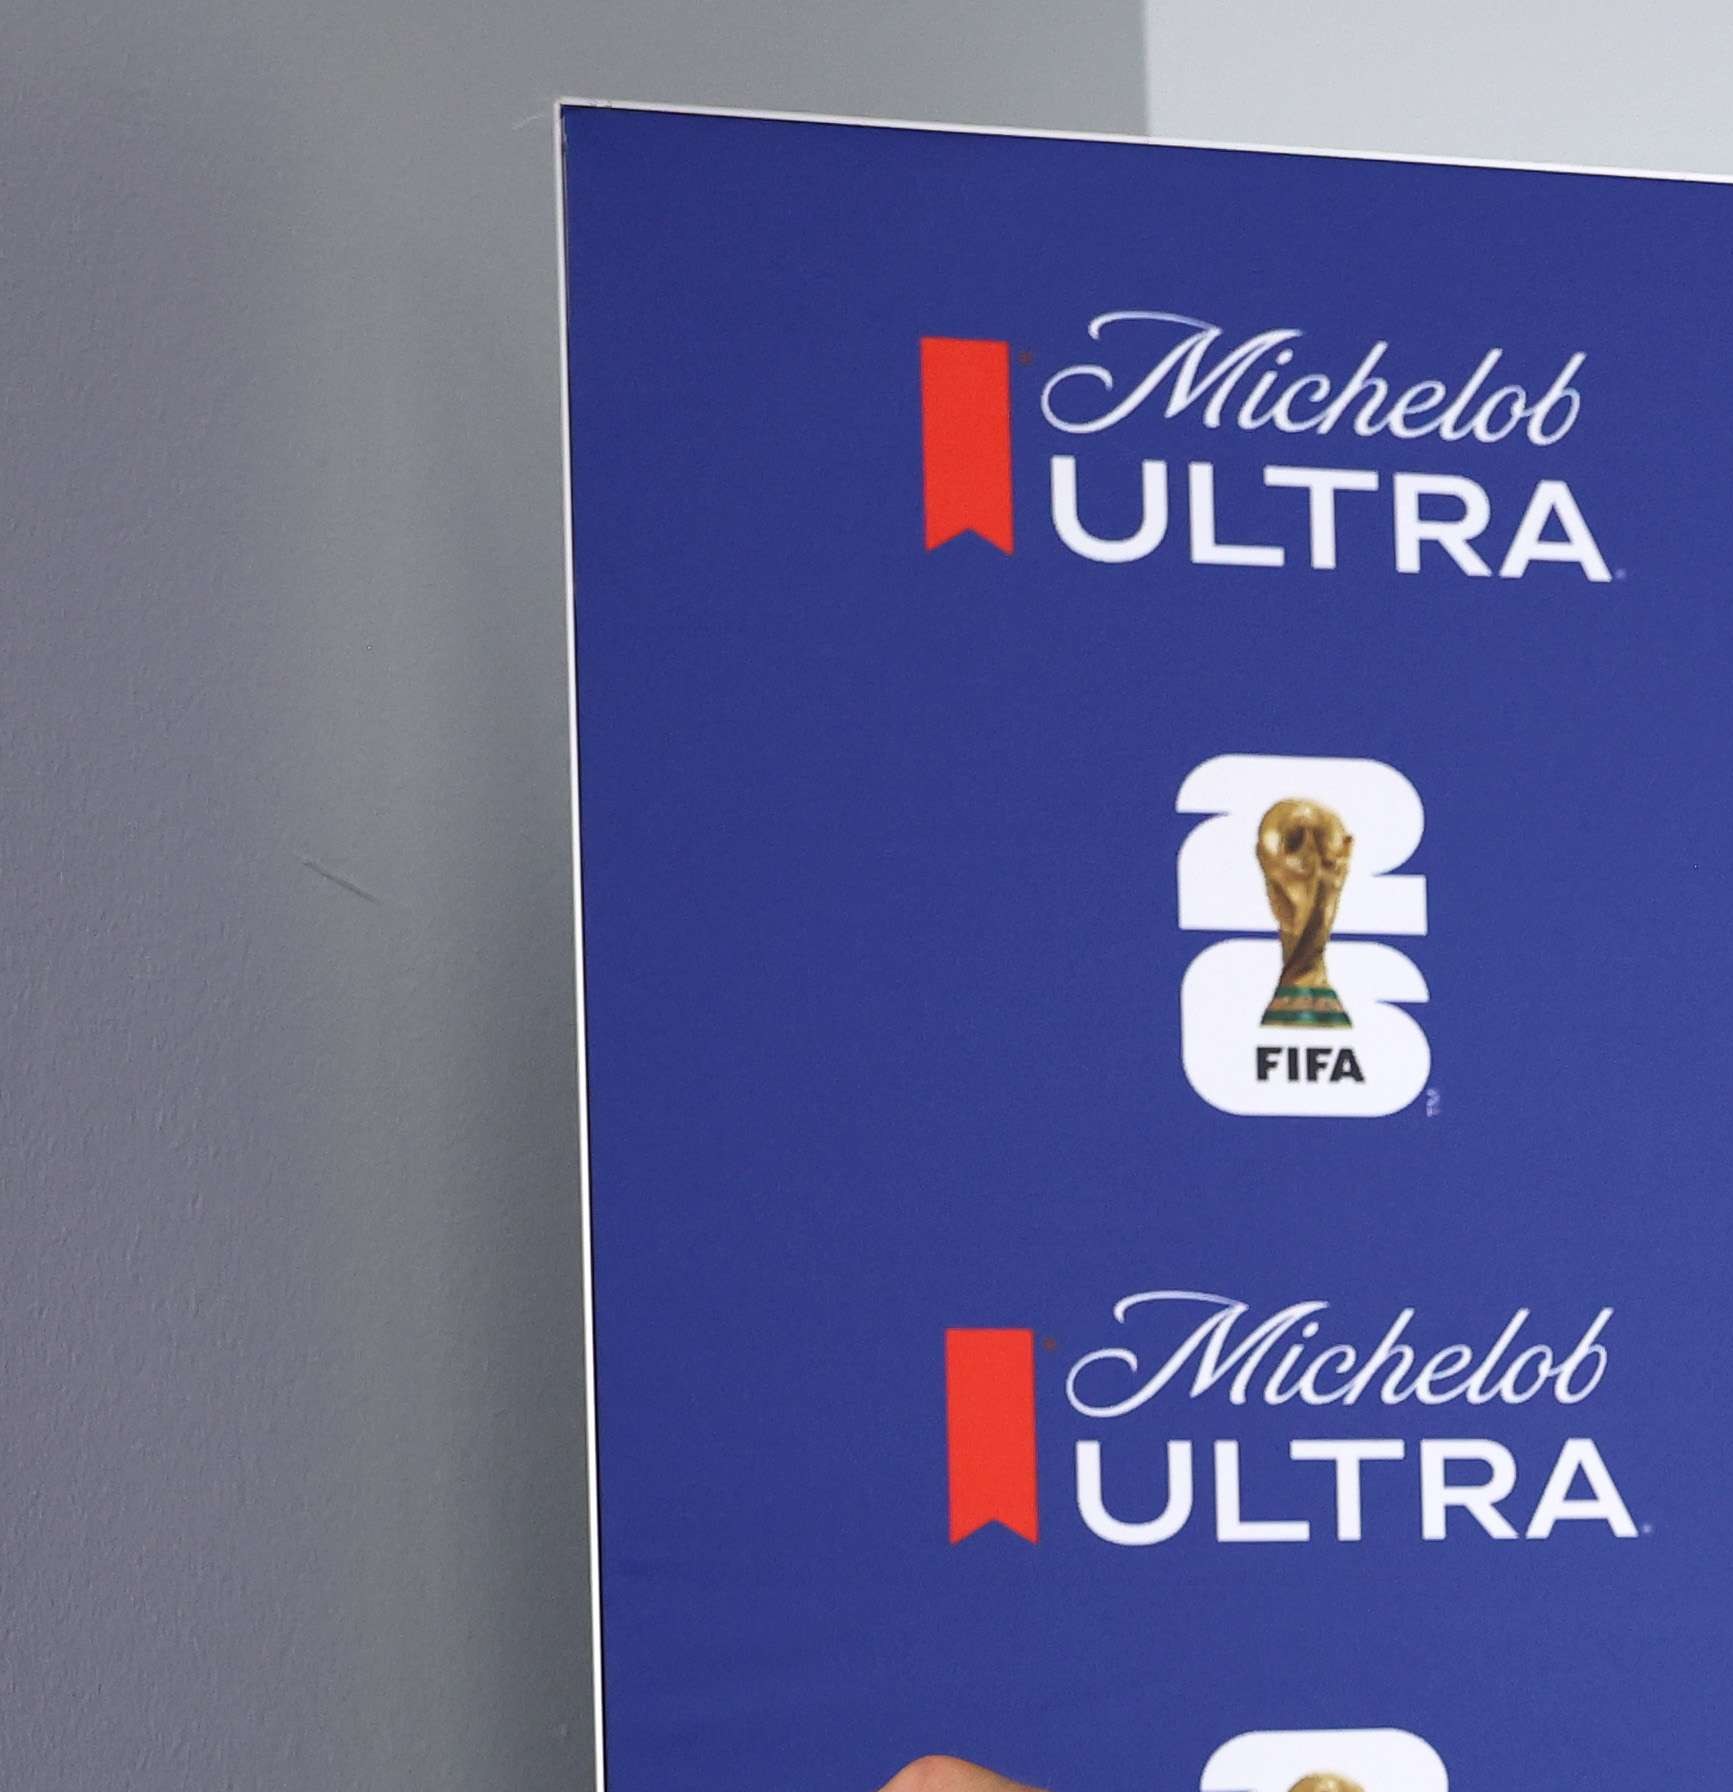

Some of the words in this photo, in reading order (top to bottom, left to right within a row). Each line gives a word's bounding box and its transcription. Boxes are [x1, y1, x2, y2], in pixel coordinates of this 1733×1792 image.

[1040, 310, 1587, 447] Michelob
[1049, 454, 1613, 583] ULTRA
[1255, 1046, 1365, 1083] FIFA
[1065, 1289, 1615, 1418] Michelob
[1075, 1438, 1639, 1547] ULTRA
